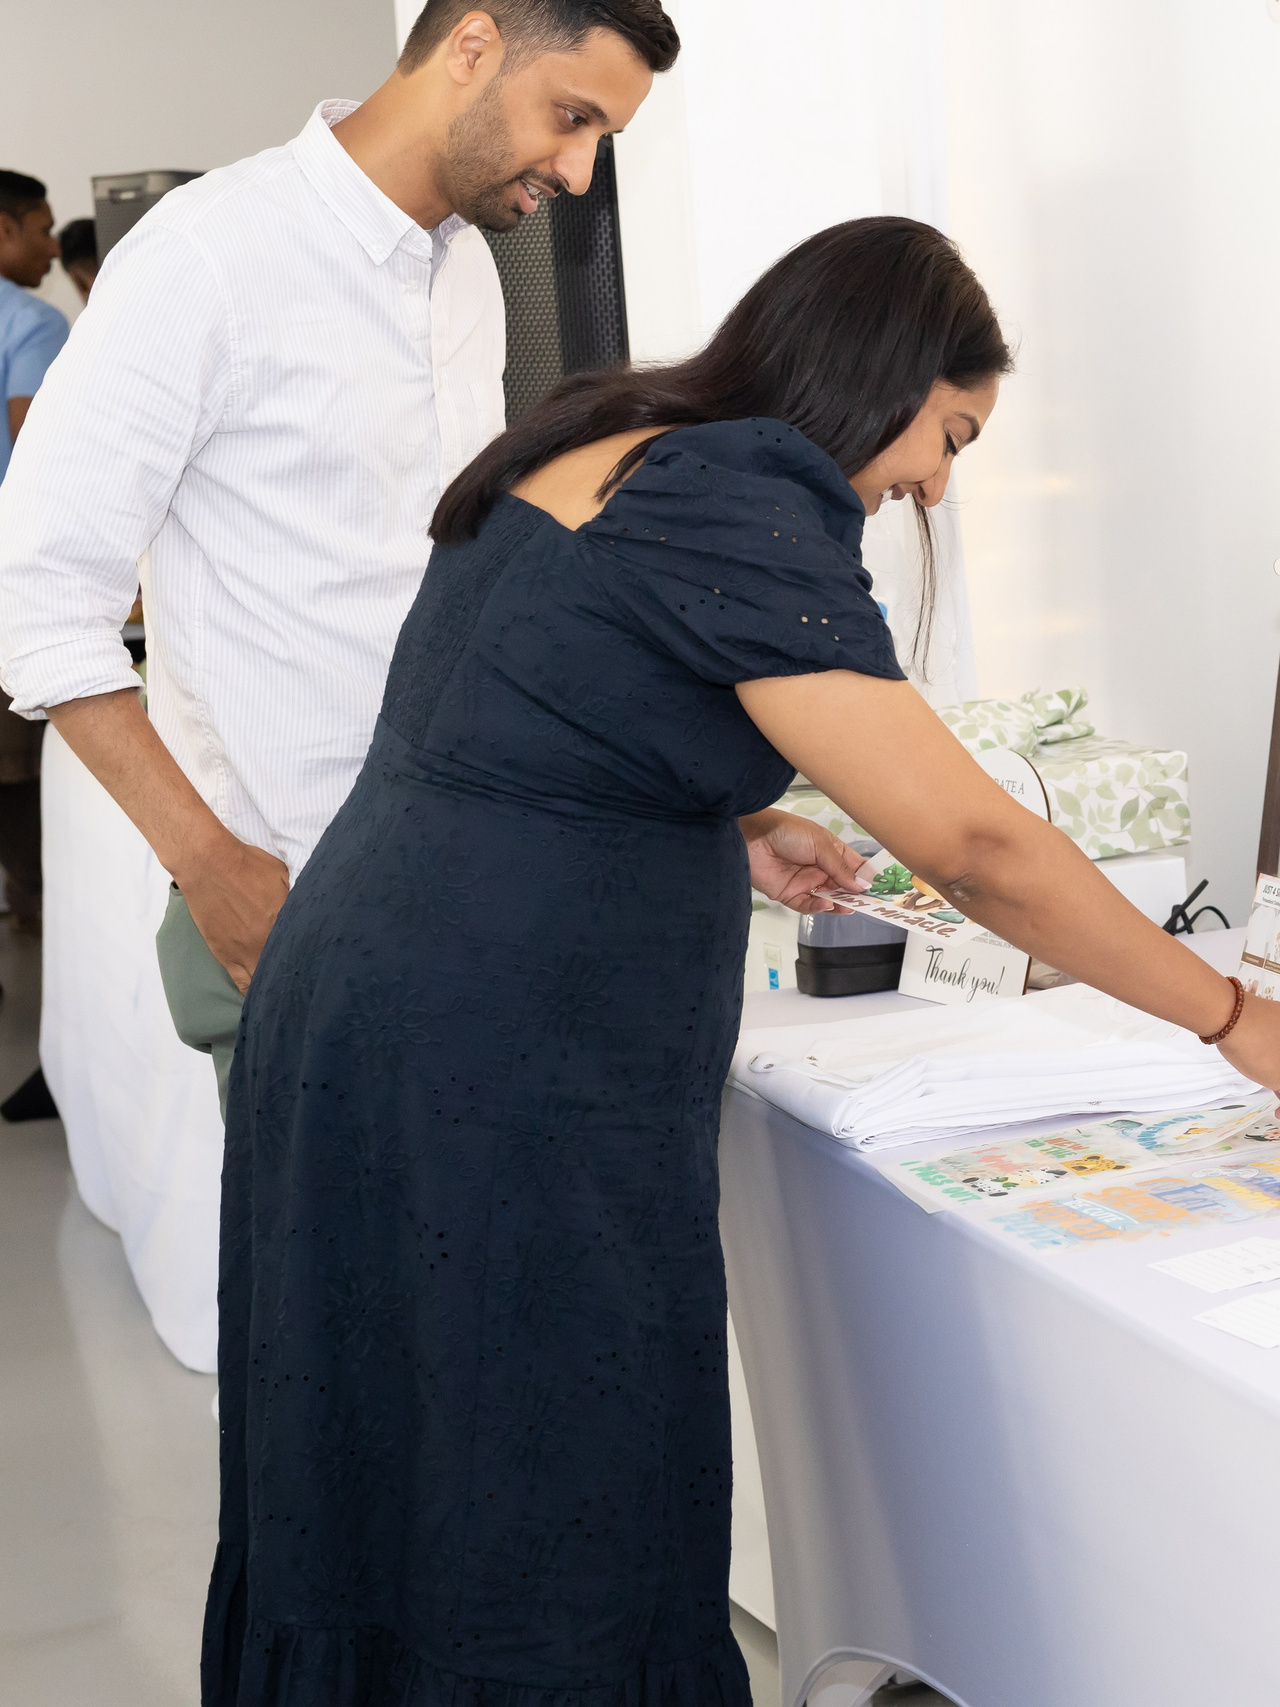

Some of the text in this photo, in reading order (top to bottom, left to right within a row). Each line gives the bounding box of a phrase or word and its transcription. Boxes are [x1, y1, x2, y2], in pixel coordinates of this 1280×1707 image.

[925, 945, 1005, 1002] Thank you!
[1082, 1207, 1124, 1223] CUTE
